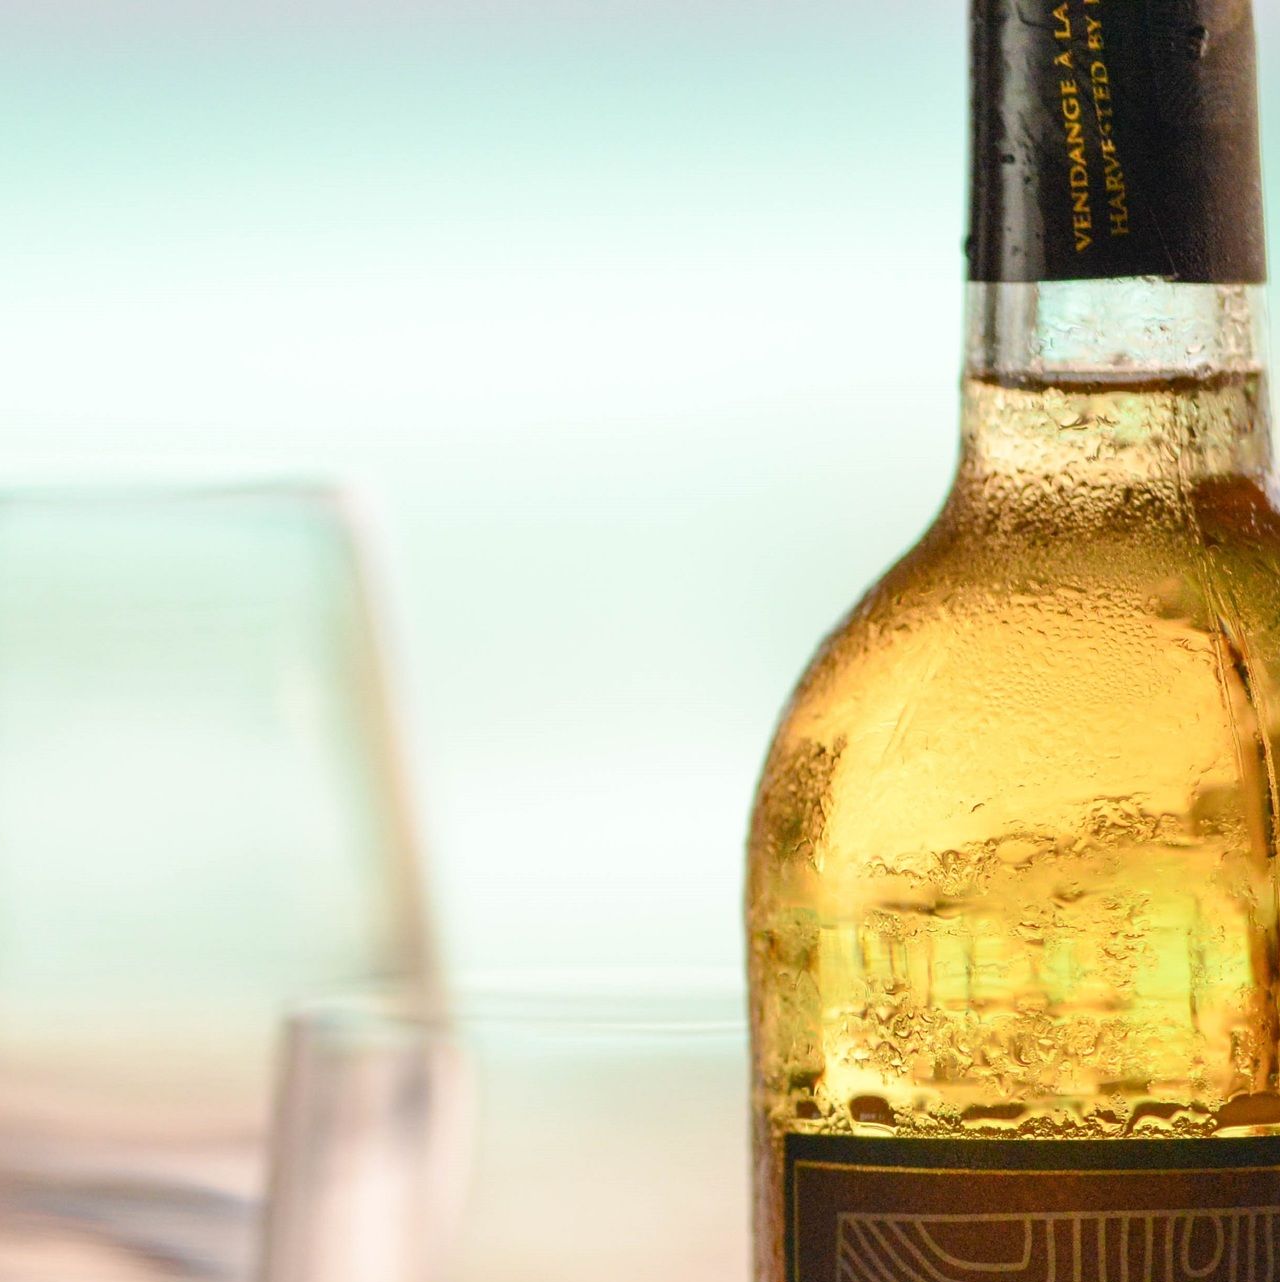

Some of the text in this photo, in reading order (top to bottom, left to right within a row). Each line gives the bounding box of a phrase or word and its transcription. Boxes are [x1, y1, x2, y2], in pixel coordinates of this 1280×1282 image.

[1052, 1, 1071, 39] LA
[1084, 14, 1104, 50] BY
[1060, 79, 1094, 251] VENDANGE
[1090, 61, 1129, 236] HARVESTED
